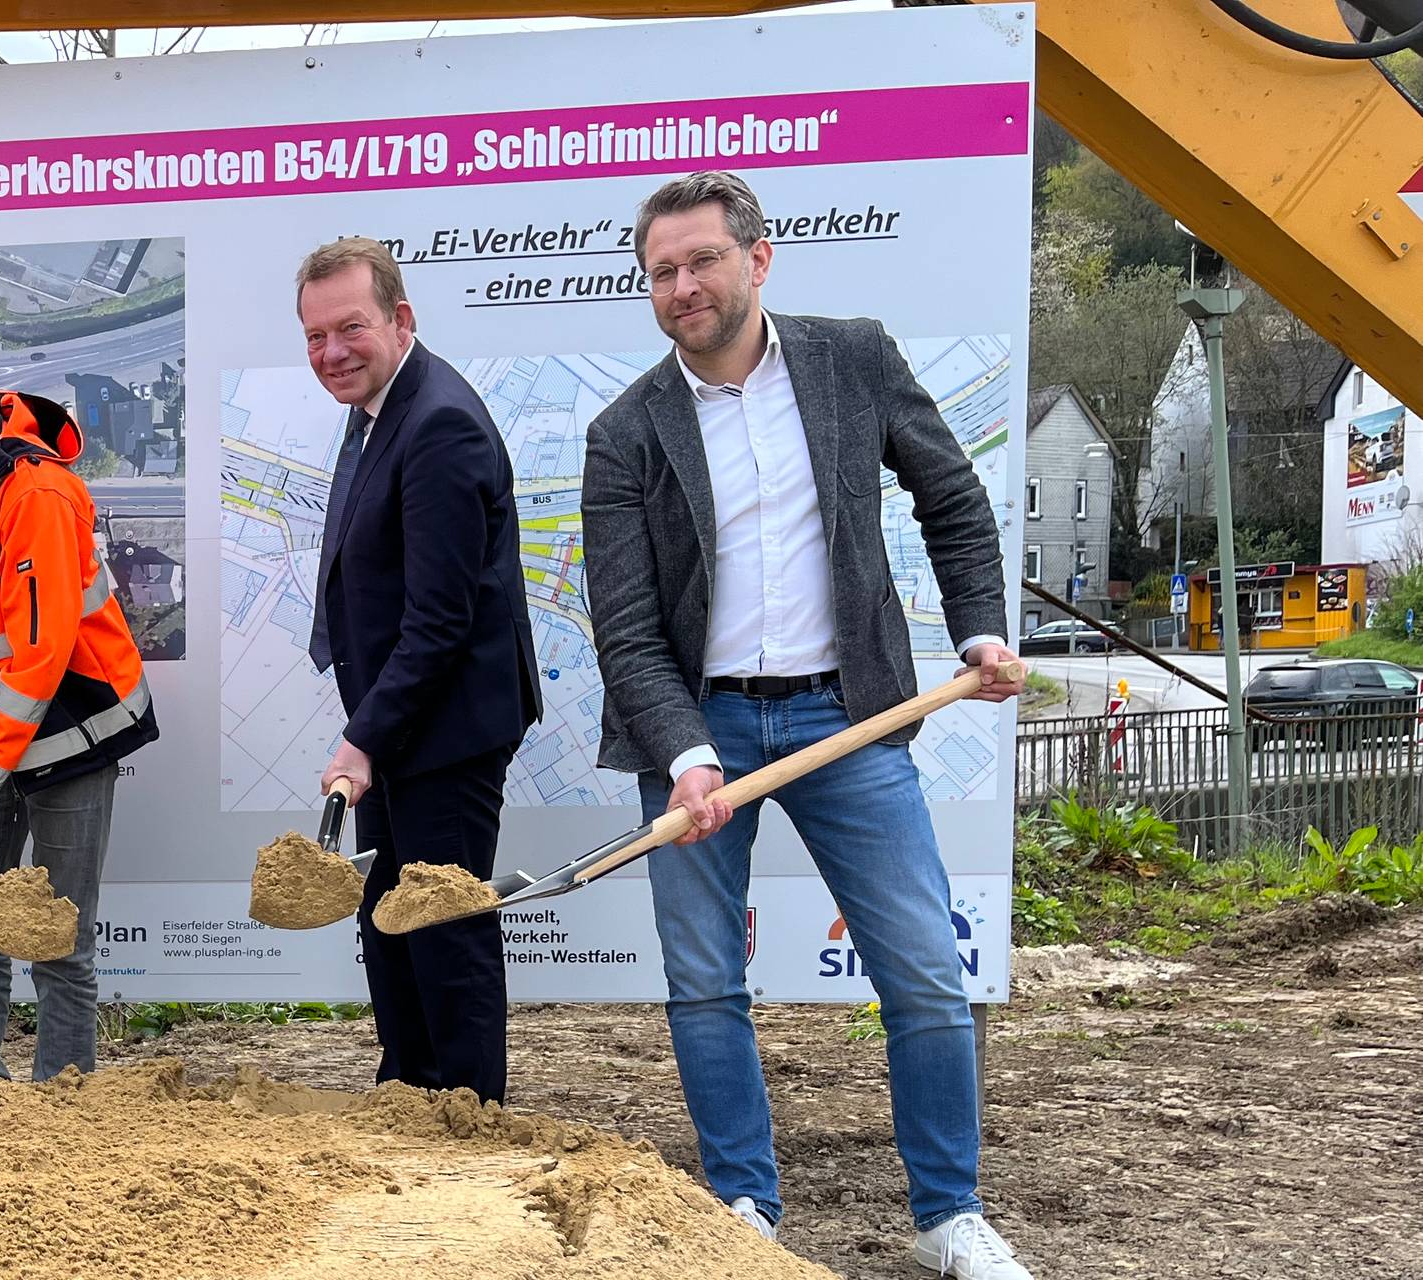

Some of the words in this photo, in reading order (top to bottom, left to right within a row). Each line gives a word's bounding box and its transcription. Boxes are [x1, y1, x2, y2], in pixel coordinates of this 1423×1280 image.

[273, 131, 449, 184] B54/L719
[456, 109, 839, 178] „Schleifmühlchen“
[411, 218, 611, 263] „Ei-Verkehr“
[763, 205, 900, 239] sverkehr
[485, 271, 552, 301] eine
[561, 267, 650, 297] runde
[532, 495, 551, 505] BUS
[498, 910, 560, 926] mwelt,
[94, 921, 147, 942] Plan
[163, 920, 224, 930] Eiserfelder
[227, 920, 265, 930] Straße
[163, 934, 198, 944] 57080
[202, 933, 242, 945] Siegen
[502, 930, 568, 943] Verkehr
[163, 947, 281, 959] www.plusplan-ing.de
[503, 950, 637, 963] hein-Westfalen
